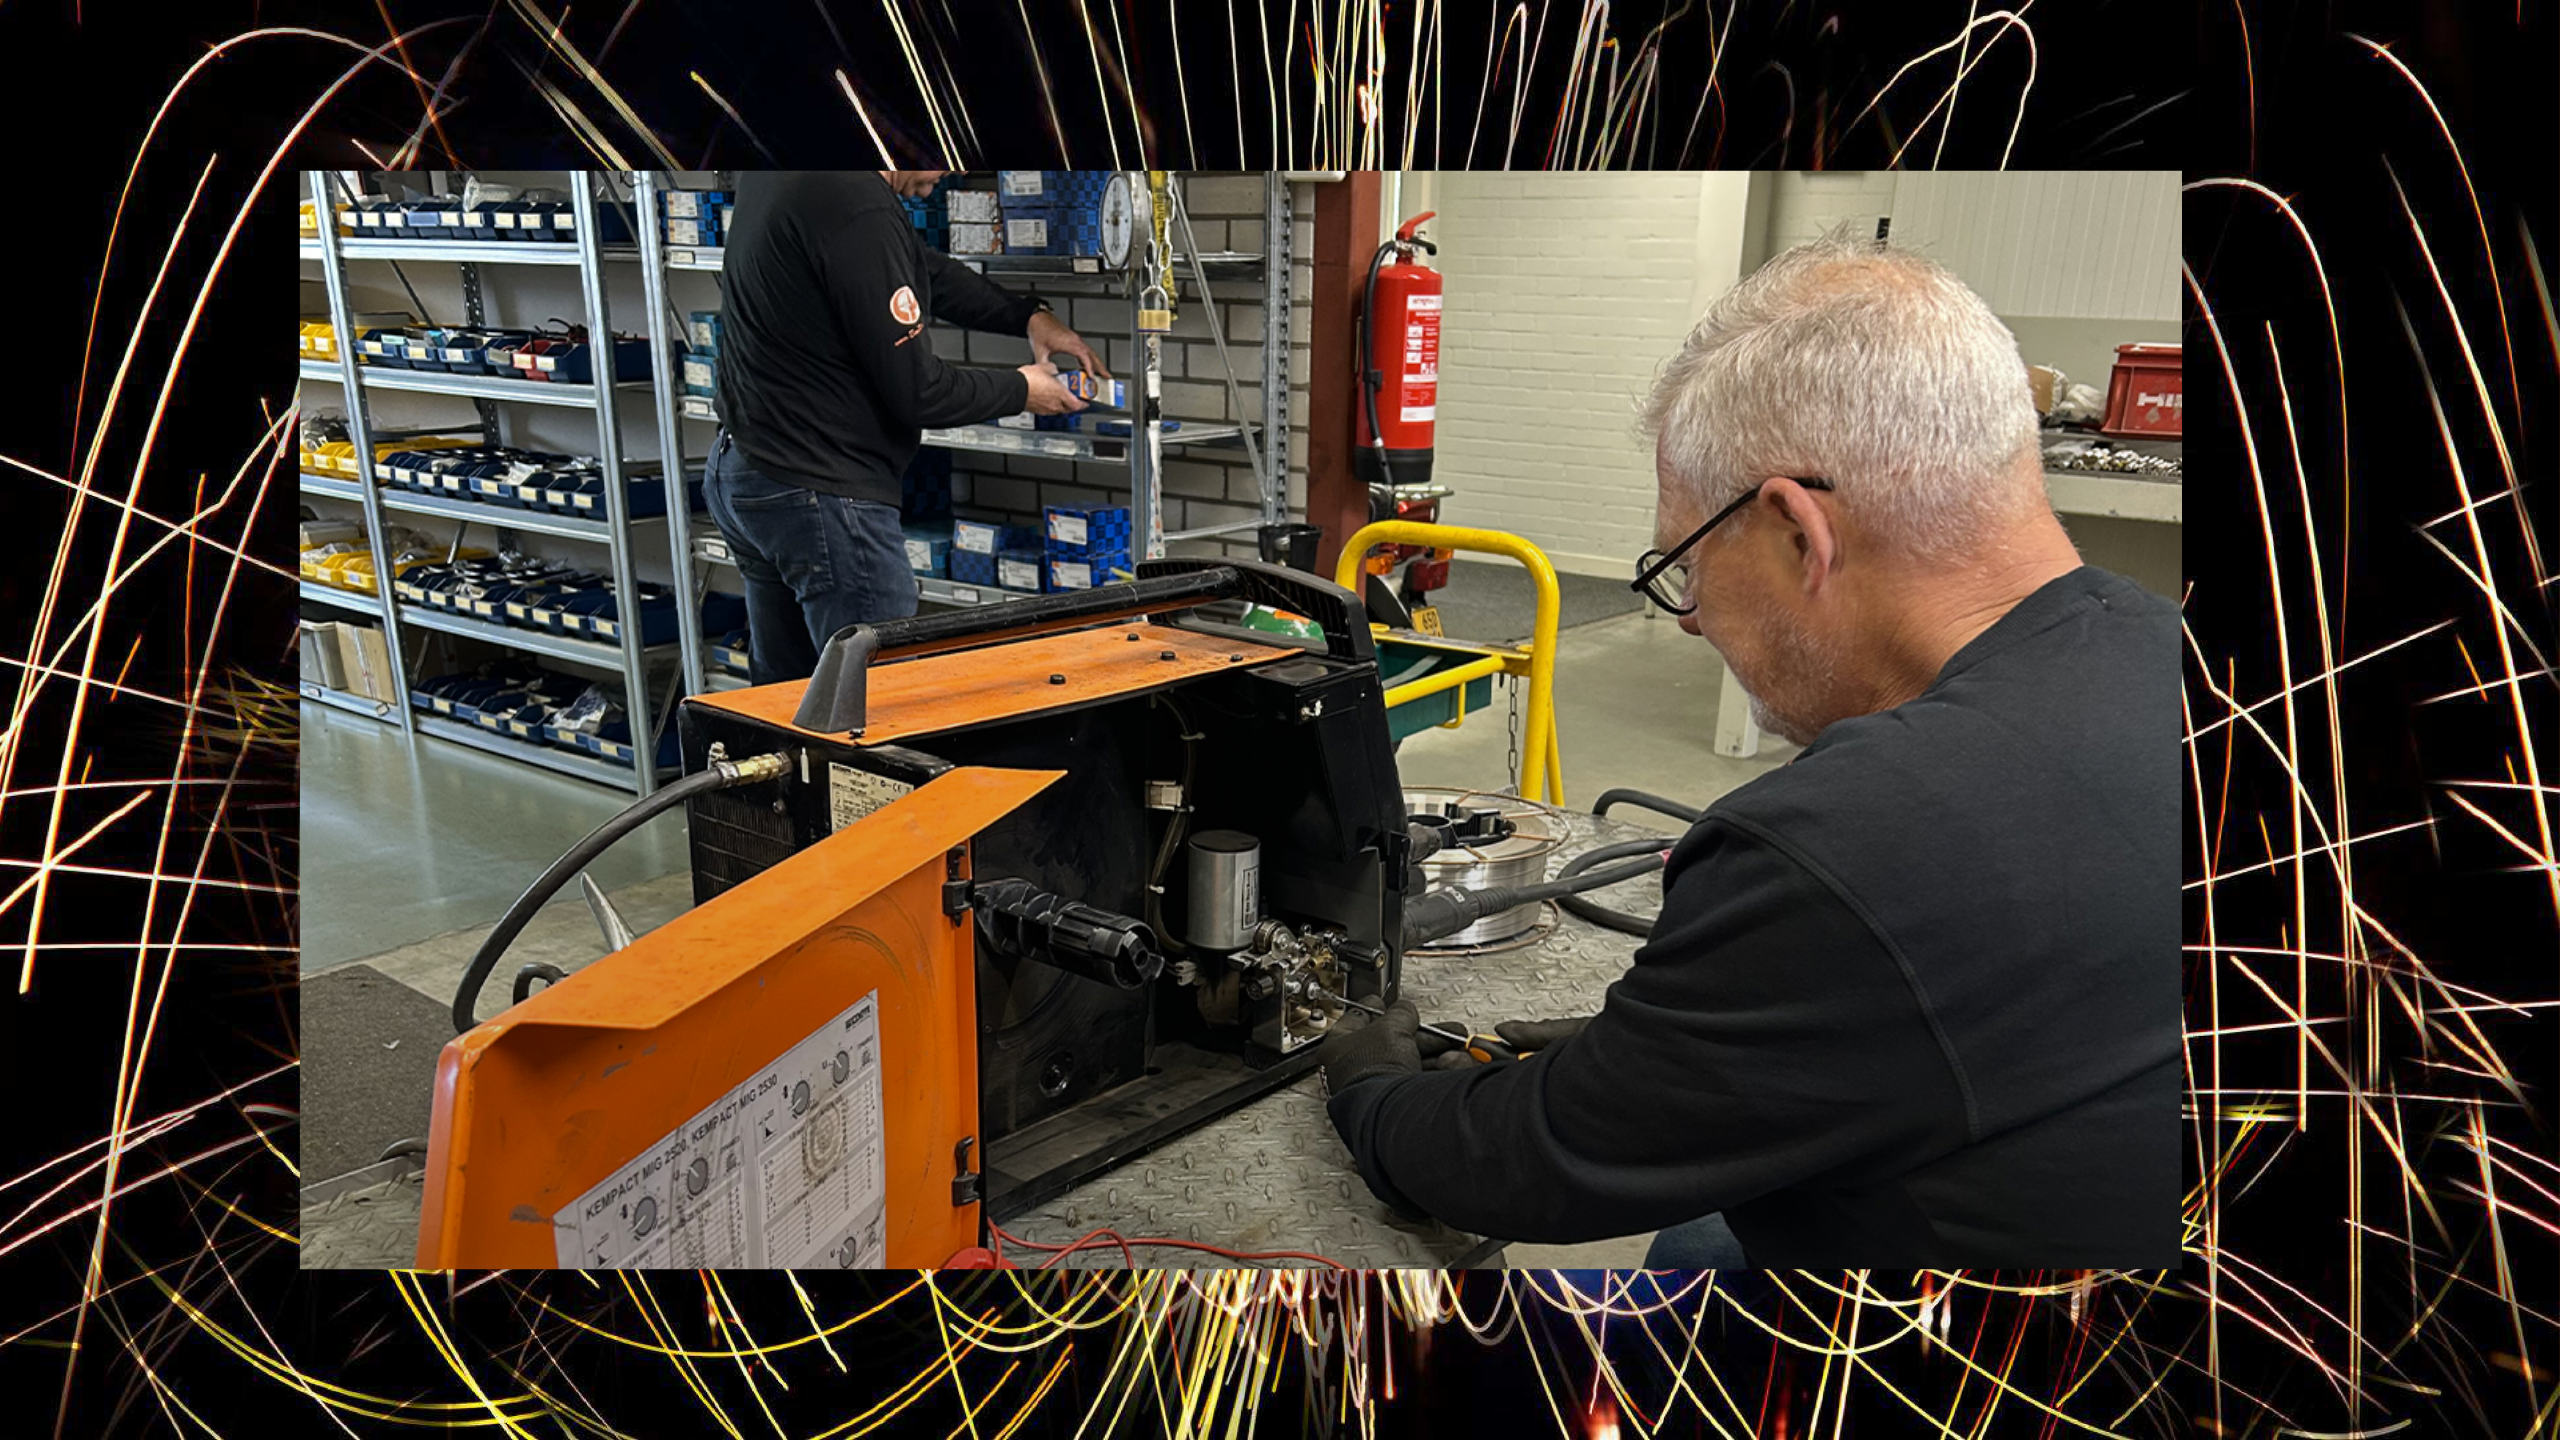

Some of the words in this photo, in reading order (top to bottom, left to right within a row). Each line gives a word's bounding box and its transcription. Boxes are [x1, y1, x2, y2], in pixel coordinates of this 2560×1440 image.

[1070, 375, 1079, 390] 2
[586, 1172, 640, 1220] KEMPACT
[643, 1156, 663, 1181] MIG
[691, 1103, 737, 1142] KEMPACT
[740, 1088, 757, 1110] MIG
[758, 1073, 777, 1096] 2530
